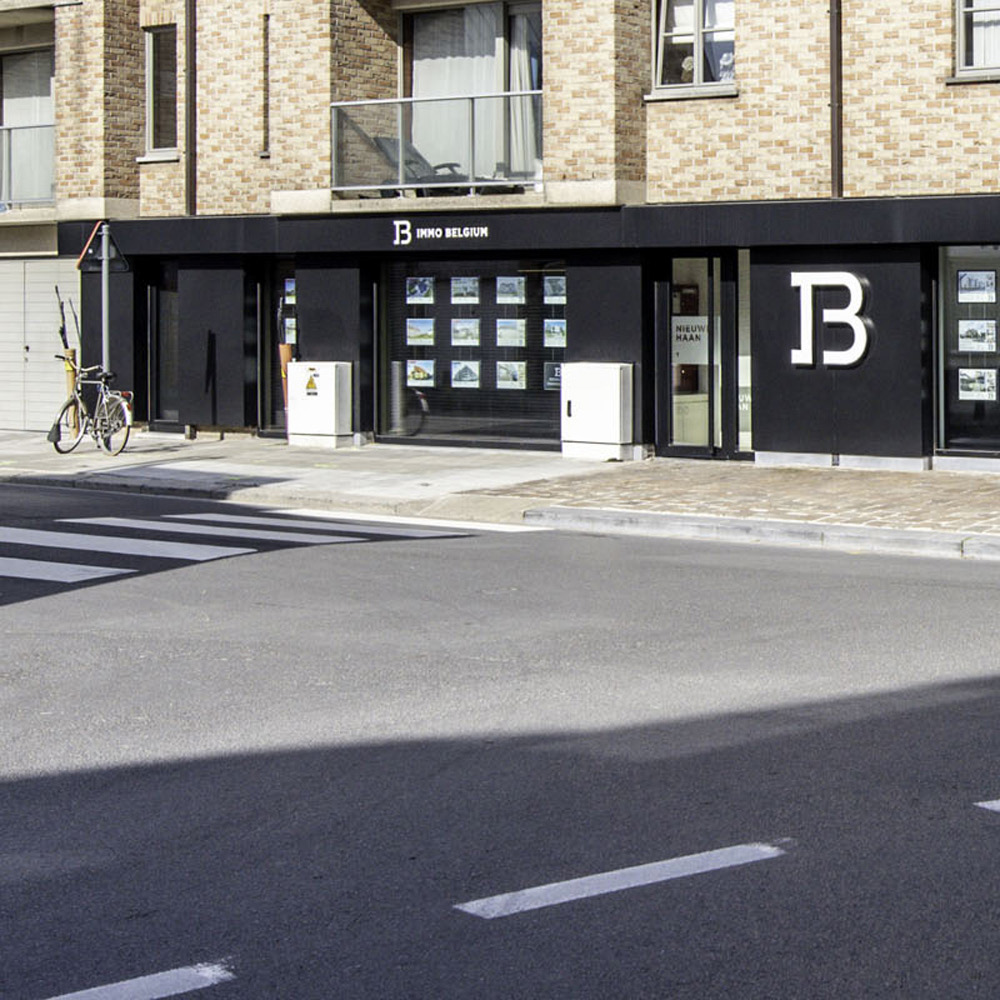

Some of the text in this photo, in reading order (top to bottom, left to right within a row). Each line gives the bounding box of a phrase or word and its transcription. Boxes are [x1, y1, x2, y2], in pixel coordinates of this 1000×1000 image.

[393, 220, 488, 245] B IMMO BELGIUM
[791, 271, 868, 365] B
[676, 334, 701, 342] HAAN
